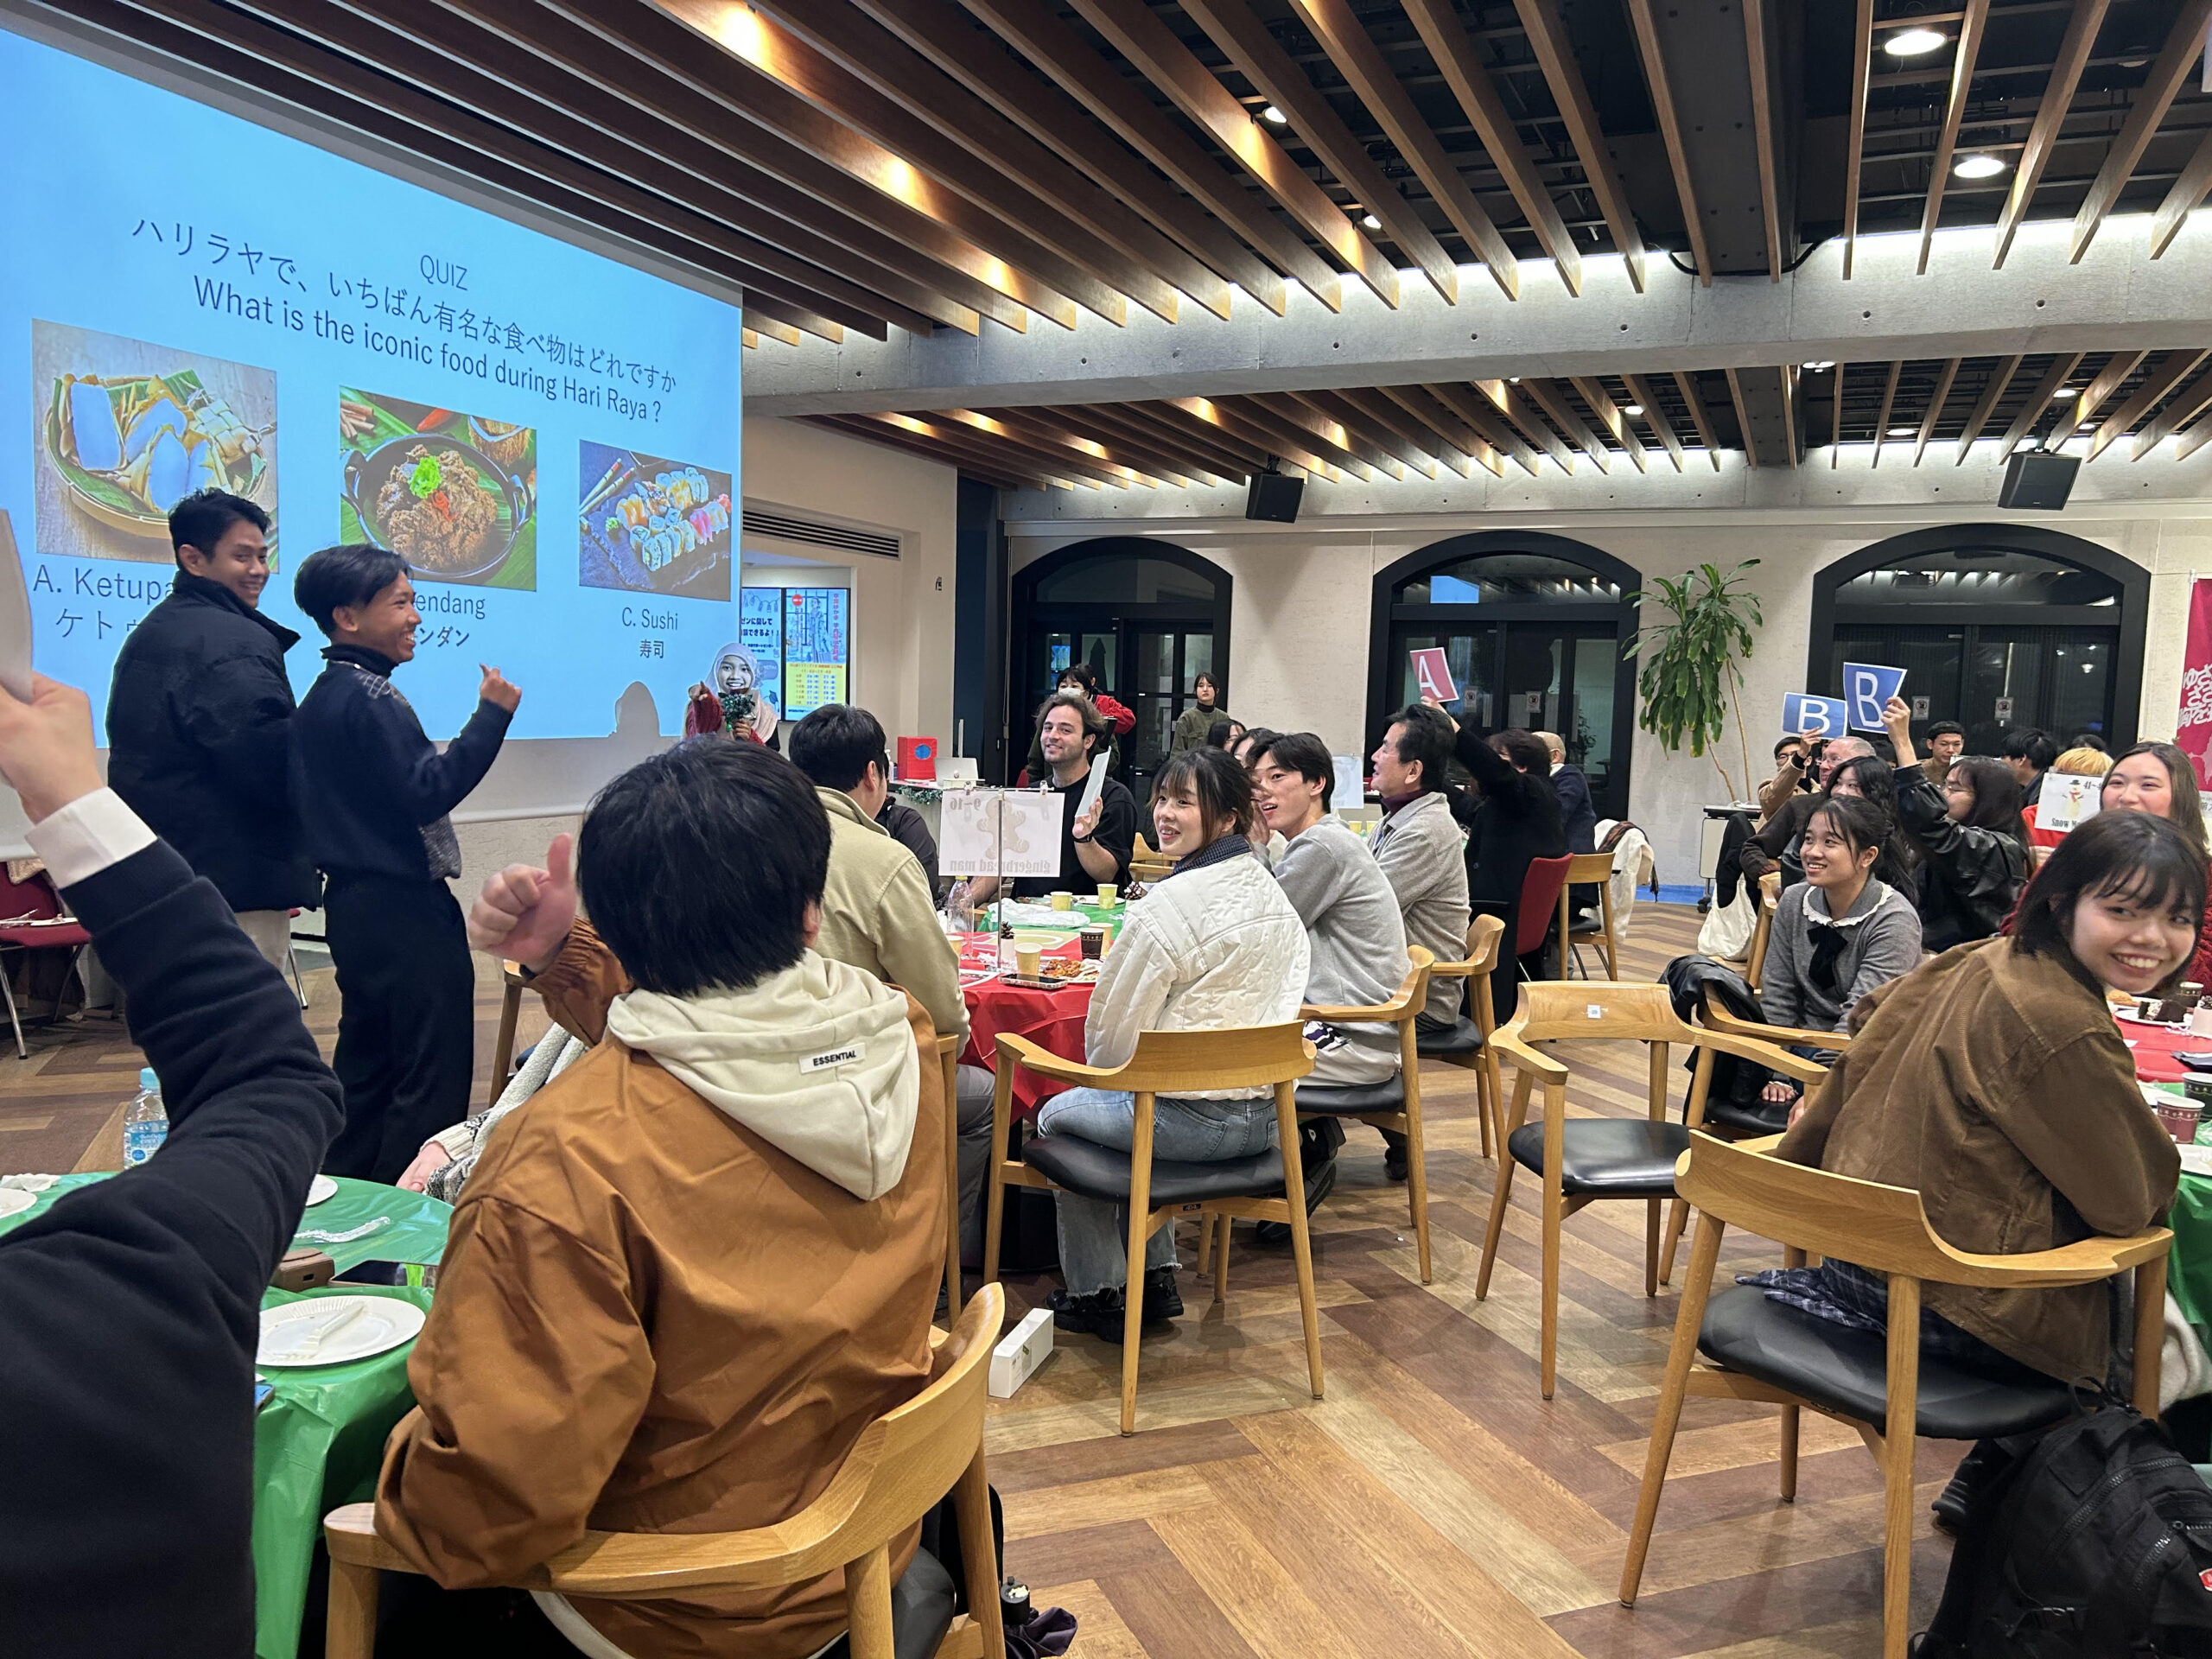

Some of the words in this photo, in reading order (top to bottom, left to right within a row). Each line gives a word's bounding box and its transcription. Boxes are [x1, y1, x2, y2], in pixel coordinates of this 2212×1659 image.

[420, 255, 467, 290] QUIZ
[132, 219, 677, 393] ハリラヤで、いちばん有名な食べ物はどれですか
[194, 275, 273, 324] What
[283, 301, 303, 331] is
[314, 310, 353, 344] the
[364, 322, 433, 364] iconic
[441, 343, 487, 378] food
[495, 359, 556, 401] during
[563, 376, 601, 407] Hari
[607, 388, 647, 421] Raya
[652, 401, 661, 422] ?
[33, 564, 61, 593] A.
[75, 567, 174, 605] Ketupa
[415, 590, 486, 620] endang
[622, 607, 636, 626] C.
[641, 608, 678, 631] Sushi
[416, 626, 469, 647] ンダン
[639, 639, 664, 658] 寿司
[1419, 655, 1444, 698] A
[1797, 698, 1831, 734] B
[1856, 671, 1885, 728] B
[2051, 818, 2069, 828] Snow
[812, 1051, 856, 1066] ESSENTIAL
